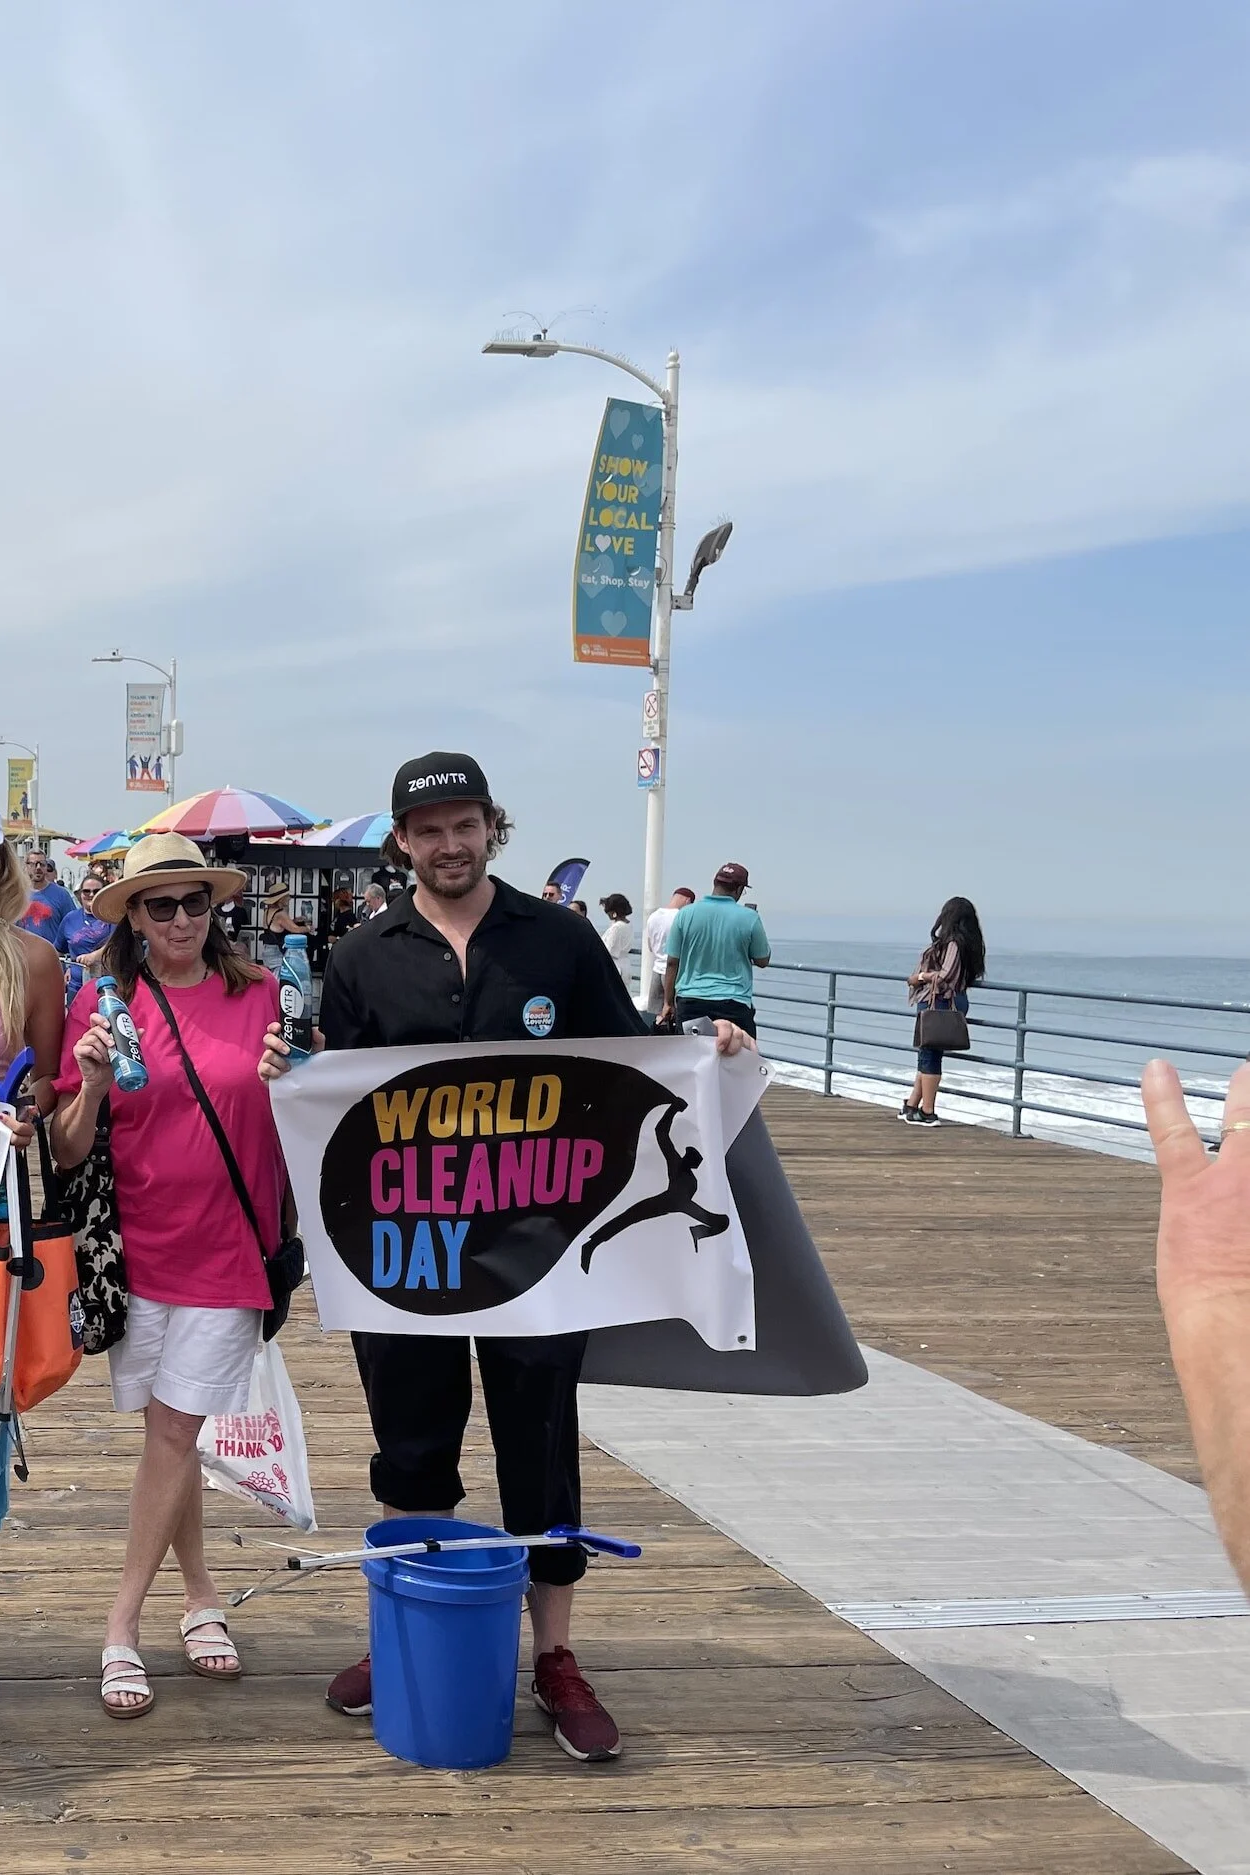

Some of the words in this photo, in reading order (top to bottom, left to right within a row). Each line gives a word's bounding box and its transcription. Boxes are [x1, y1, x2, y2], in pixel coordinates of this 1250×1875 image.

[599, 454, 648, 479] SHOW
[596, 480, 639, 504] YOUR
[588, 507, 654, 530] LOCAL
[581, 574, 598, 586] Eat,
[600, 575, 626, 588] Shop,
[628, 577, 650, 589] Stay
[372, 1074, 562, 1143] WORLD
[370, 1138, 604, 1215] CLEANUP
[371, 1220, 470, 1290] DAY
[215, 1440, 267, 1458] THANK
